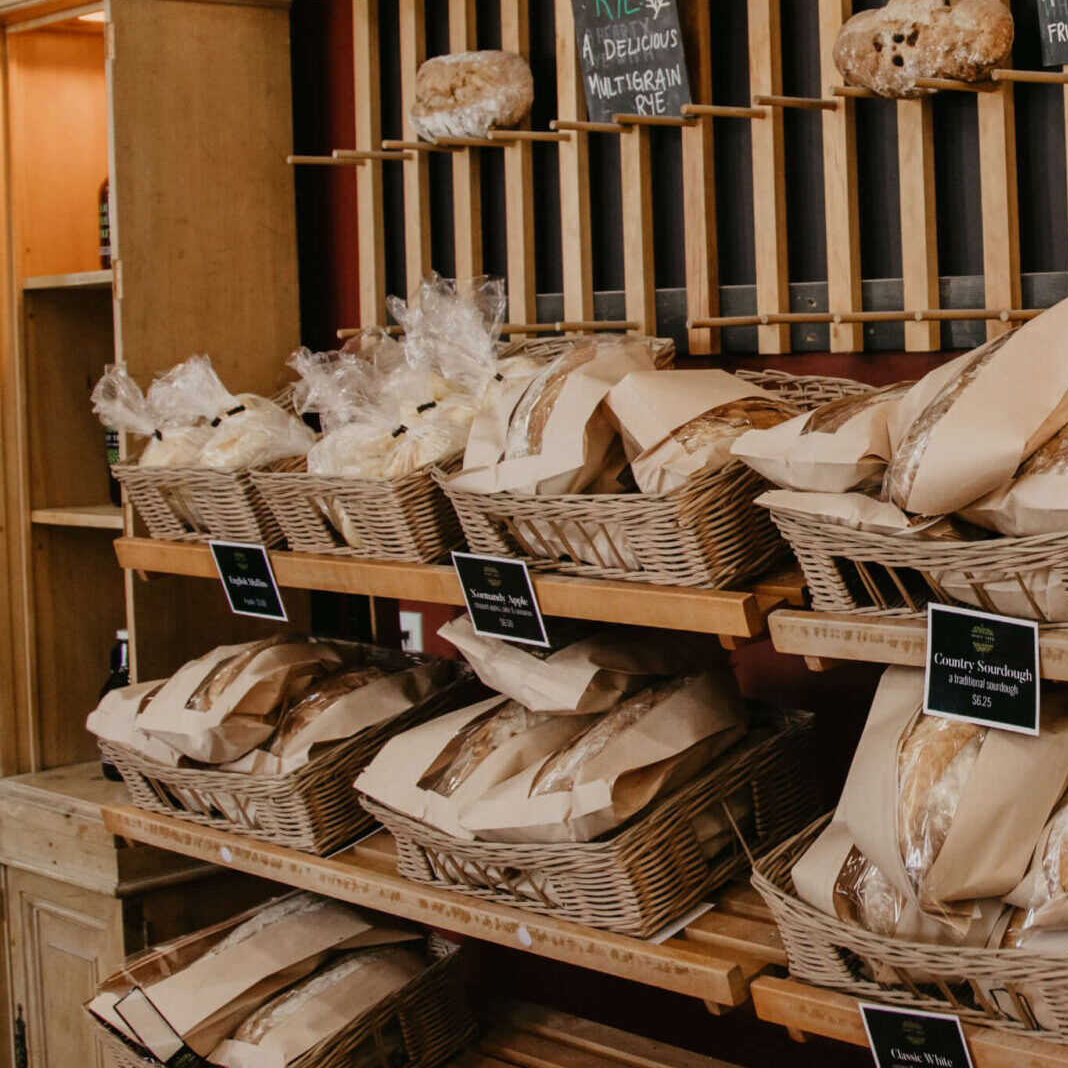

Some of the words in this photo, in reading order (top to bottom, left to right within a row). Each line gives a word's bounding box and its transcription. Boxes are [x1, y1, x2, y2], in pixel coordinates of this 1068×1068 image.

[582, 33, 595, 66] A
[603, 28, 678, 61] DELICIOUS
[588, 63, 681, 100] MULTIGRAIN
[635, 90, 666, 117] RYE
[934, 652, 975, 673] Country
[977, 659, 1033, 684] Sourdough
[954, 673, 986, 689] traditional
[986, 681, 1019, 697] sourdough
[971, 693, 992, 708] $6.25
[890, 1047, 923, 1064] Classic
[923, 1052, 953, 1068] White
